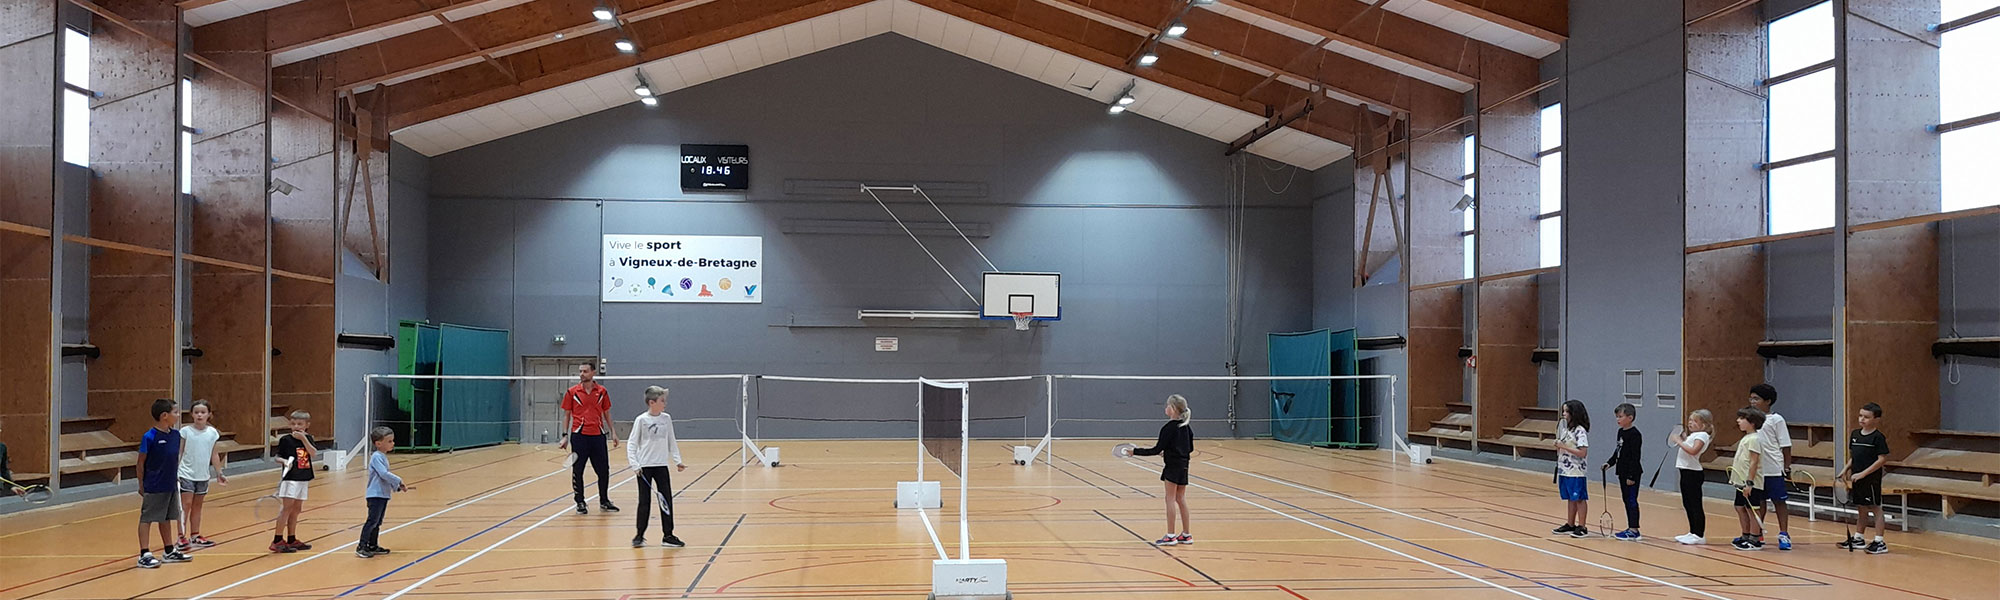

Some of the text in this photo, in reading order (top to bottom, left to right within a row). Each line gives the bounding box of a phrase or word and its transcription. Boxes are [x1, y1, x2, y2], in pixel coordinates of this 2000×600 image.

[681, 156, 749, 165] LOCAUX VISITEURS
[609, 241, 682, 251] Vive le sport
[609, 256, 758, 270] à Vigneux-de-Bretagne
